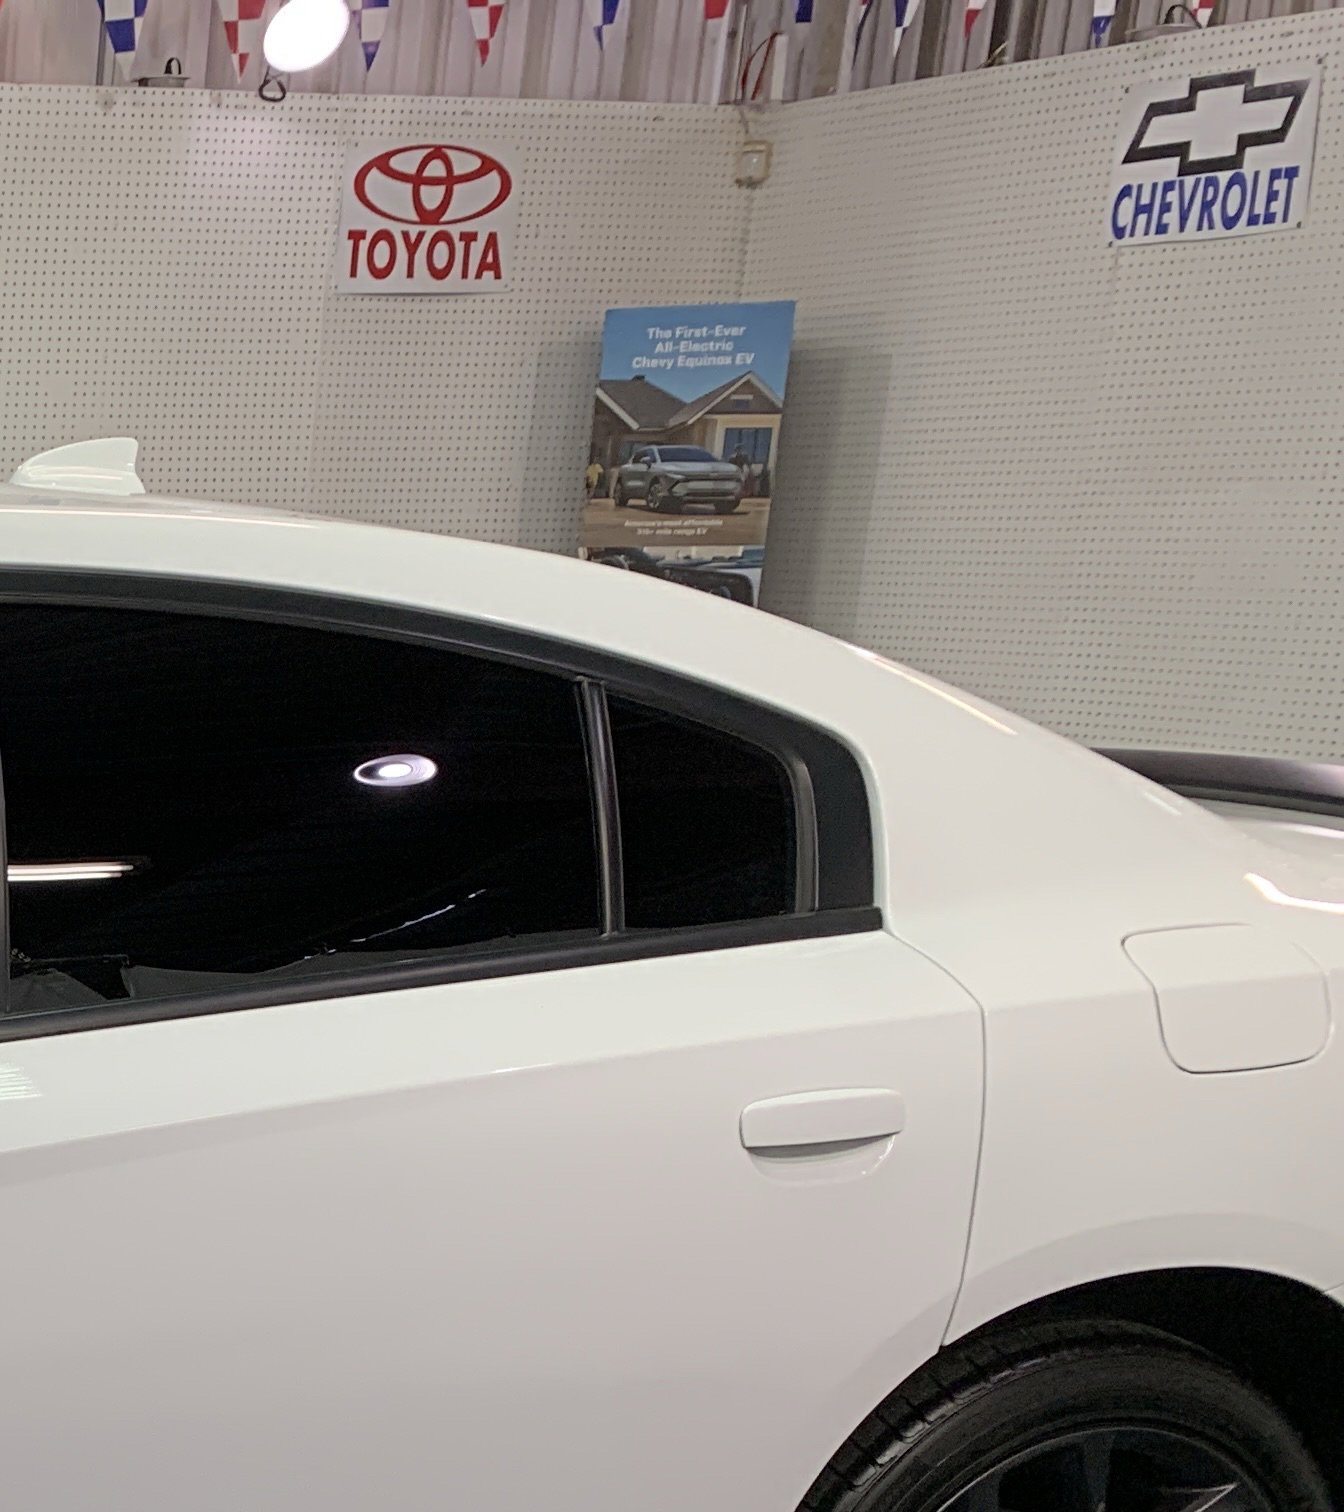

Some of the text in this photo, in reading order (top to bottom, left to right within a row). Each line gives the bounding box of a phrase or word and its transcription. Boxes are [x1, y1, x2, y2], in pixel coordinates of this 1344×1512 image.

[1111, 165, 1301, 241] CHEVROLET
[346, 228, 503, 282] TOYOTA
[647, 324, 747, 340] The First-Ever
[654, 338, 735, 354] All-Electric
[632, 352, 756, 370] Chevy Equinox EV
